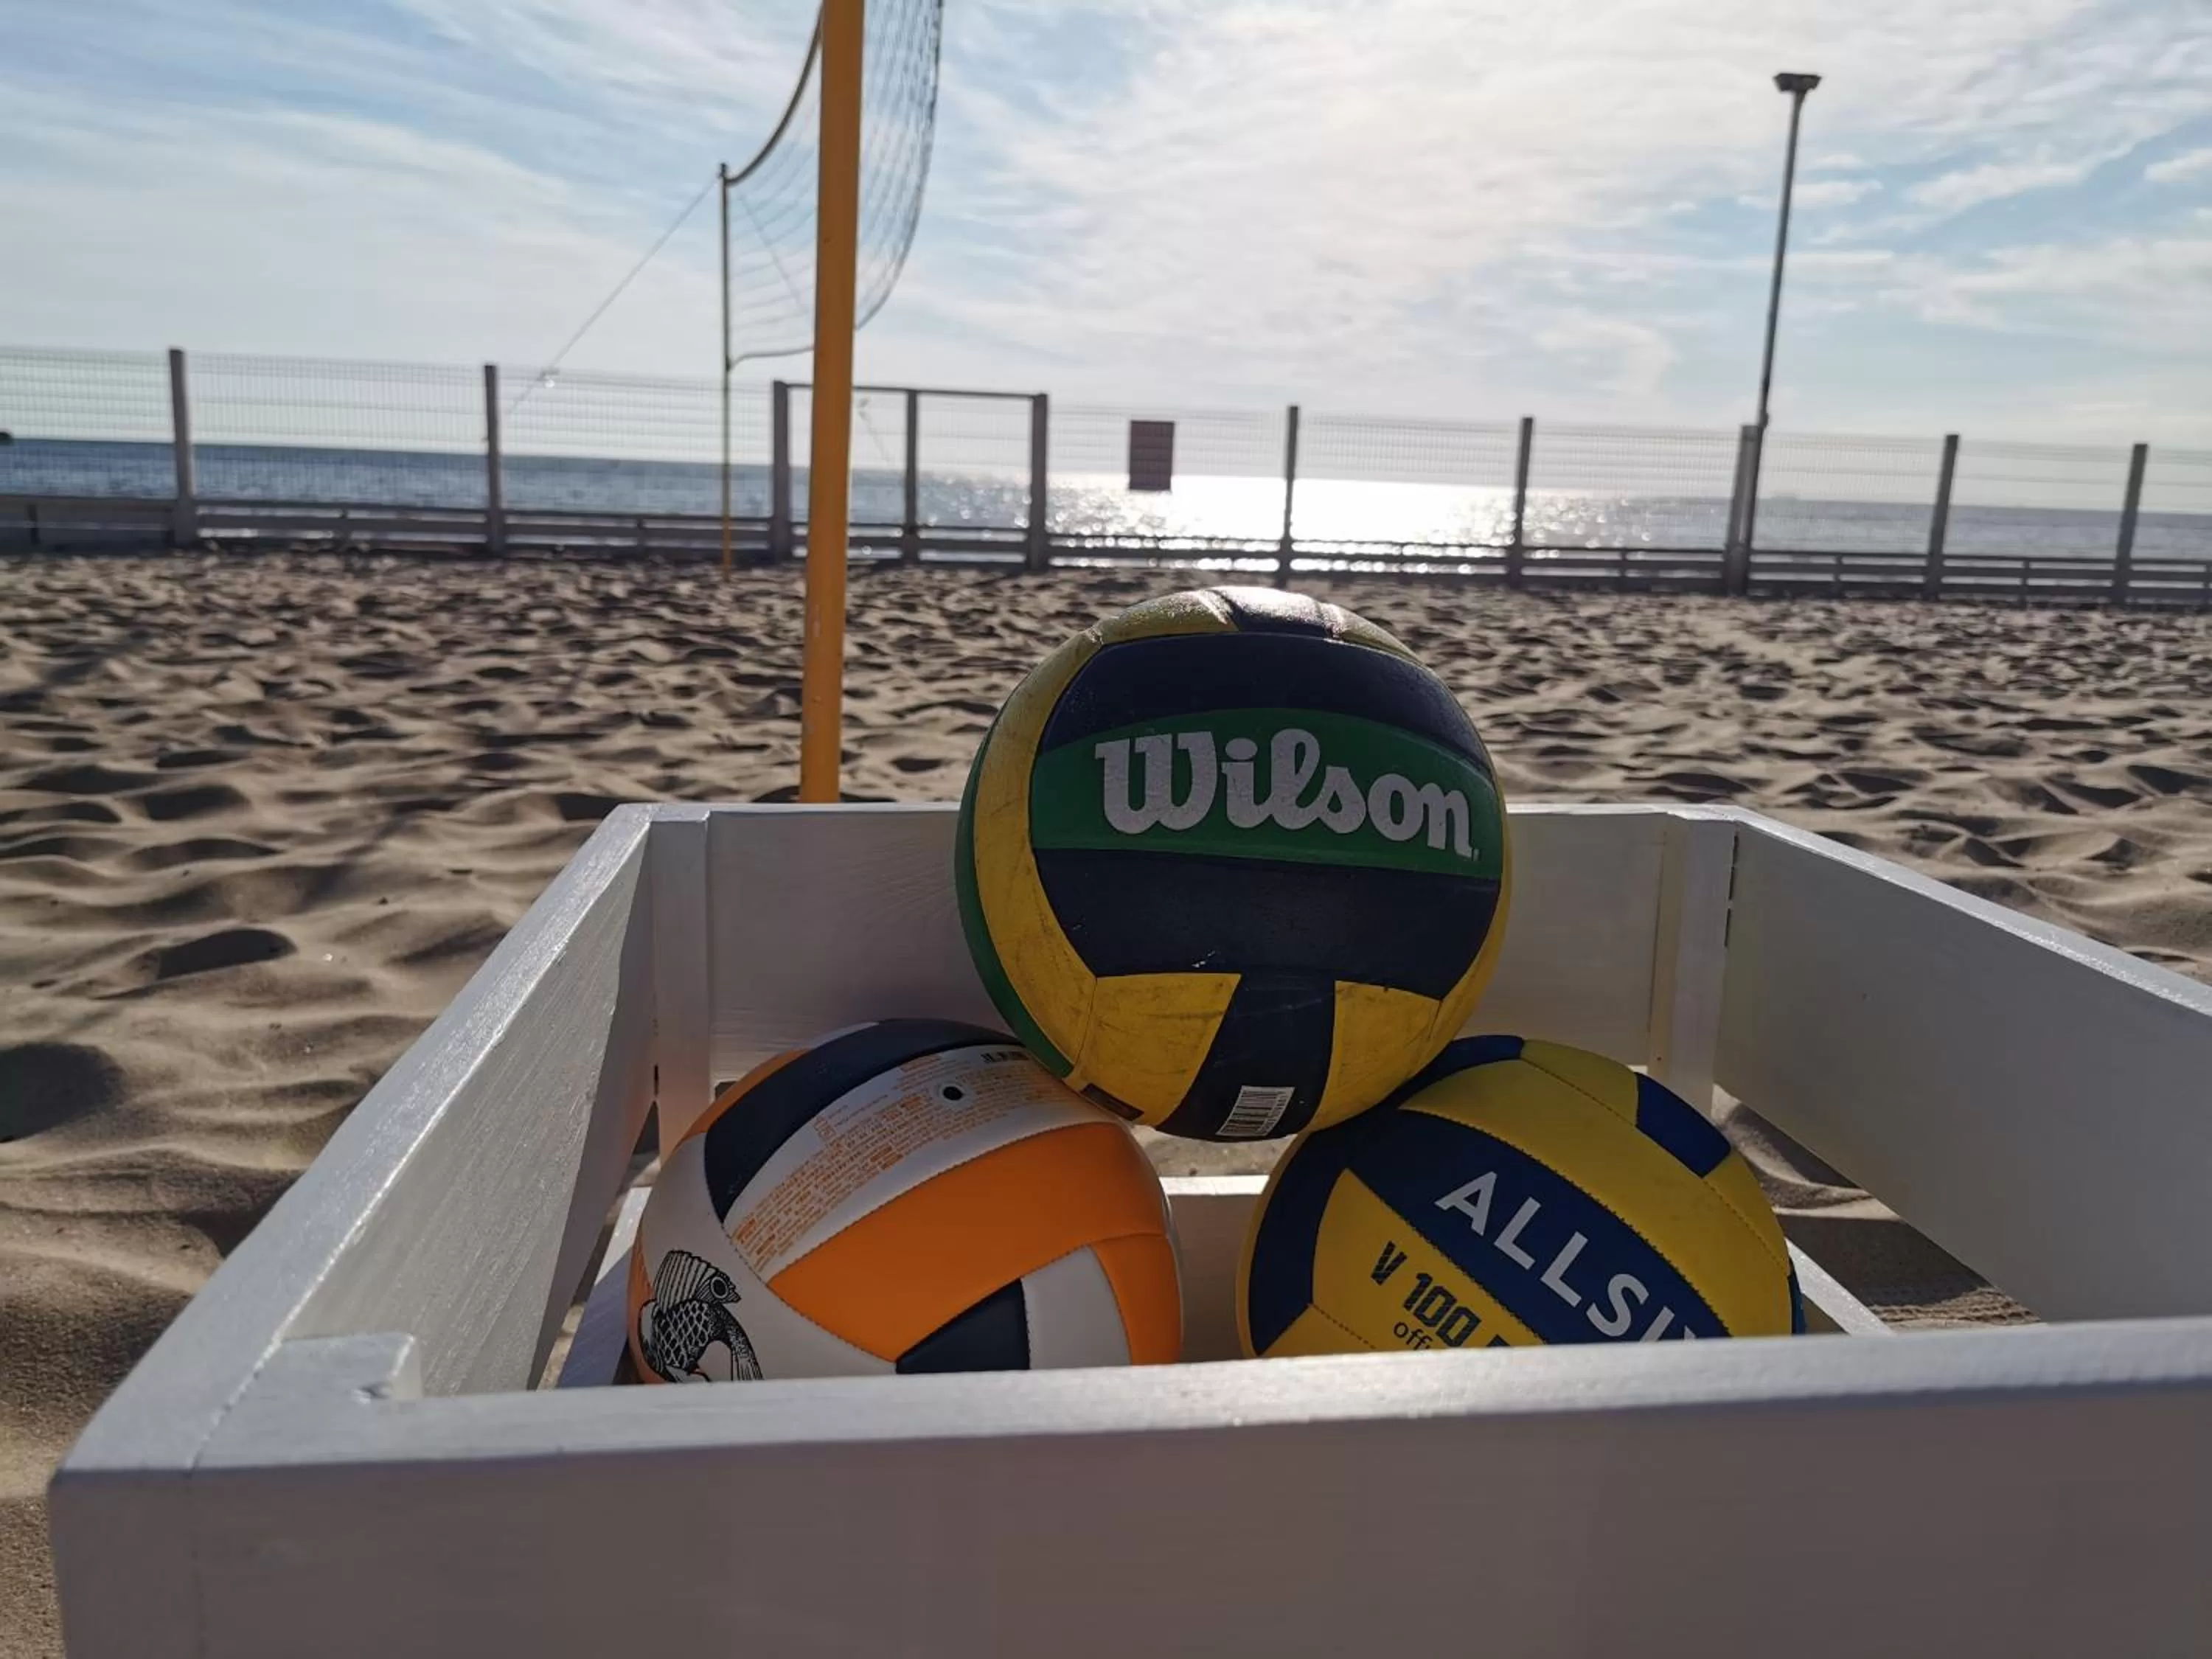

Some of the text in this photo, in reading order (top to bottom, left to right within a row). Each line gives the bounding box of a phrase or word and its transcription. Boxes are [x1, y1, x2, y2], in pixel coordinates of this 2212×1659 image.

[1094, 728, 1473, 858] Wilson
[1371, 1240, 1481, 1347] V 100
[1434, 1172, 1696, 1344] ALLSI
[1394, 1321, 1433, 1350] off
